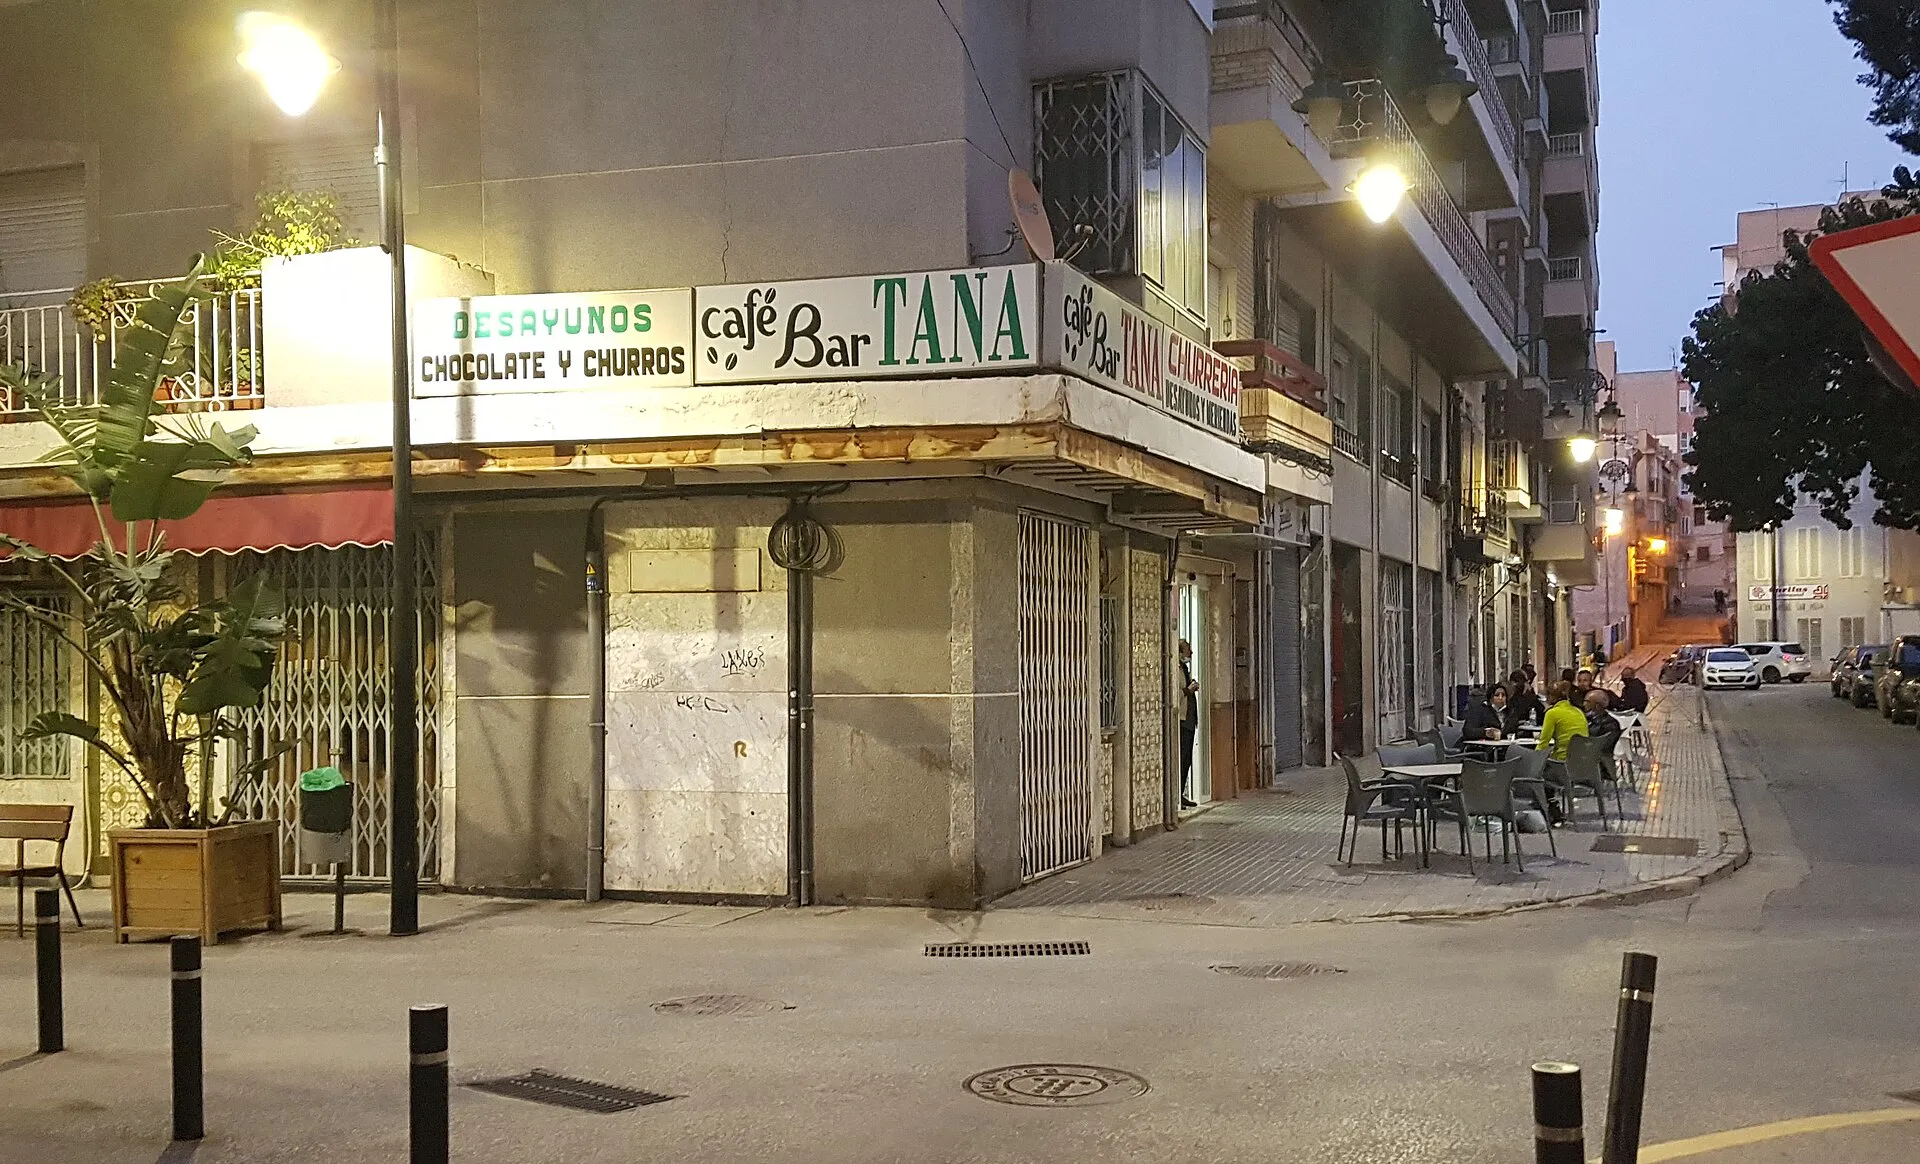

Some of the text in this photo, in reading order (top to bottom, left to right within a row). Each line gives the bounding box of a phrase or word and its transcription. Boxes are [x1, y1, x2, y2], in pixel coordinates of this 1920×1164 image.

[453, 304, 652, 339] DESAYUNOS
[701, 269, 1030, 369] café Bar TANA
[1064, 284, 1163, 401] café Bar TANA
[421, 346, 685, 382] CHOCOLATE Y CHURROS
[1168, 332, 1239, 406] CHURRERIA
[1165, 379, 1200, 422] DESAYUNOS
[1200, 396, 1206, 424] Y
